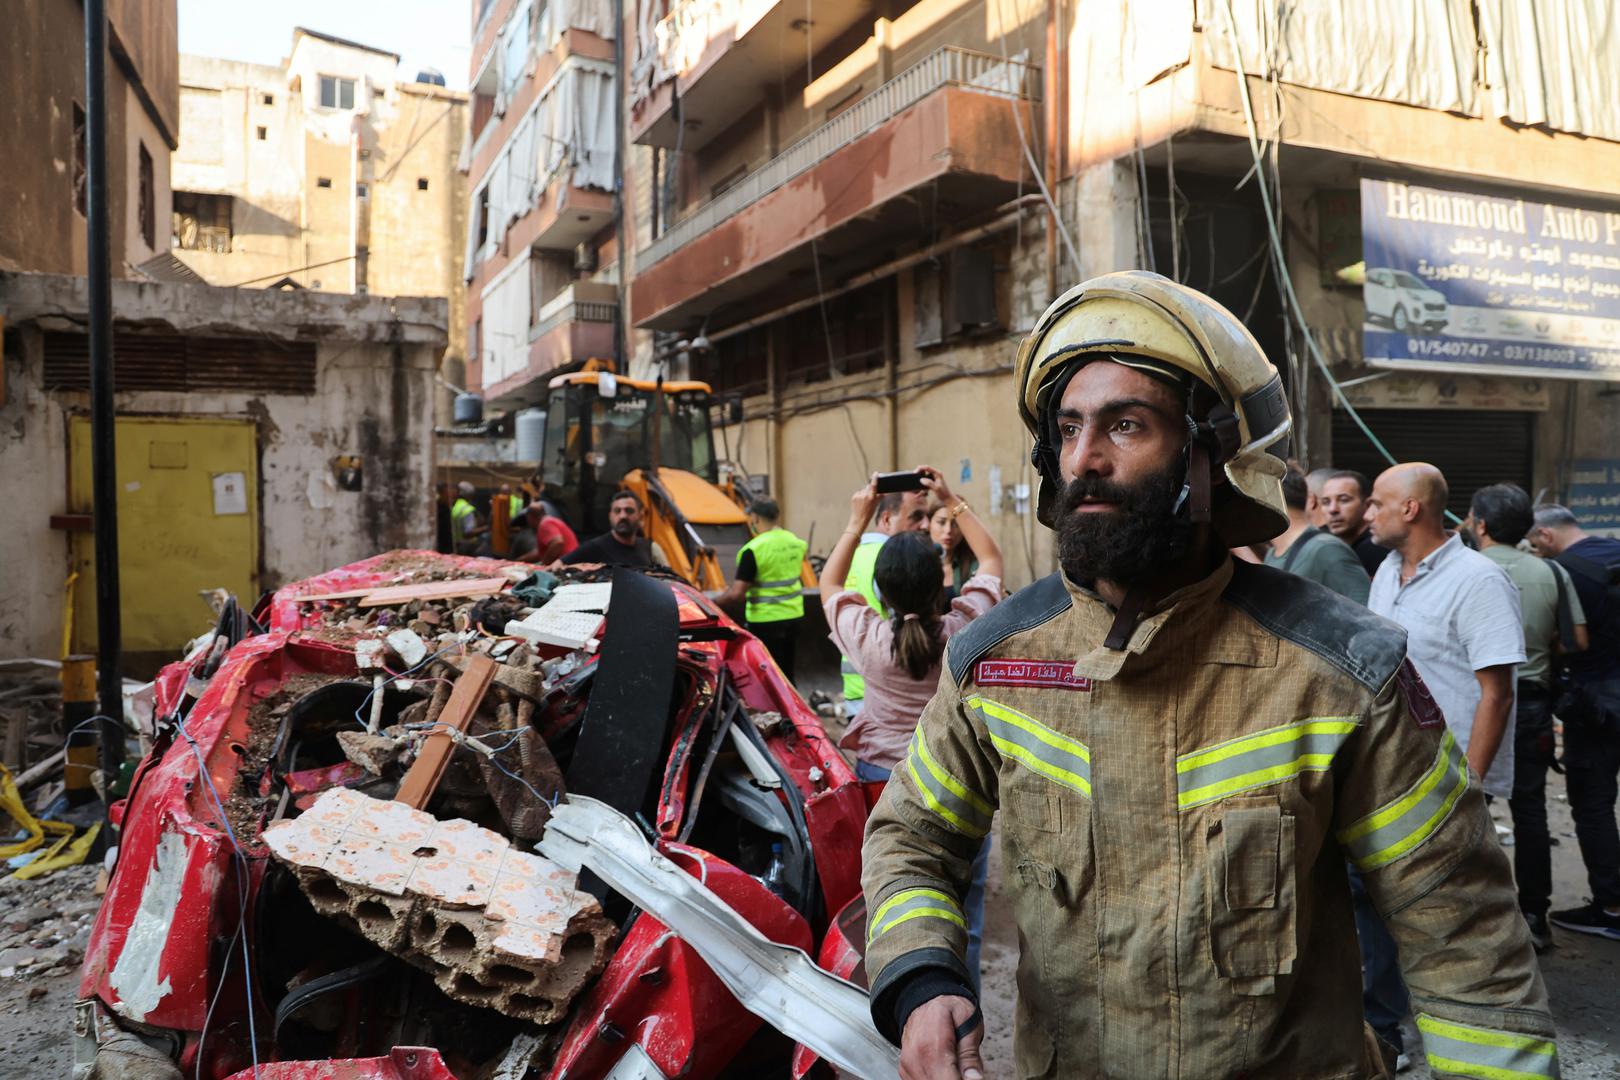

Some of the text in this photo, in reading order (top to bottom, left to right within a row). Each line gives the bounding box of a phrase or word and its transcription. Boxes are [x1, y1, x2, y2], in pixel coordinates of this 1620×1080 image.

[1386, 181, 1527, 234] Hammoud
[1541, 204, 1598, 244] Auto
[1407, 338, 1489, 357] 01/540747
[984, 665, 1031, 680] الضاحية
